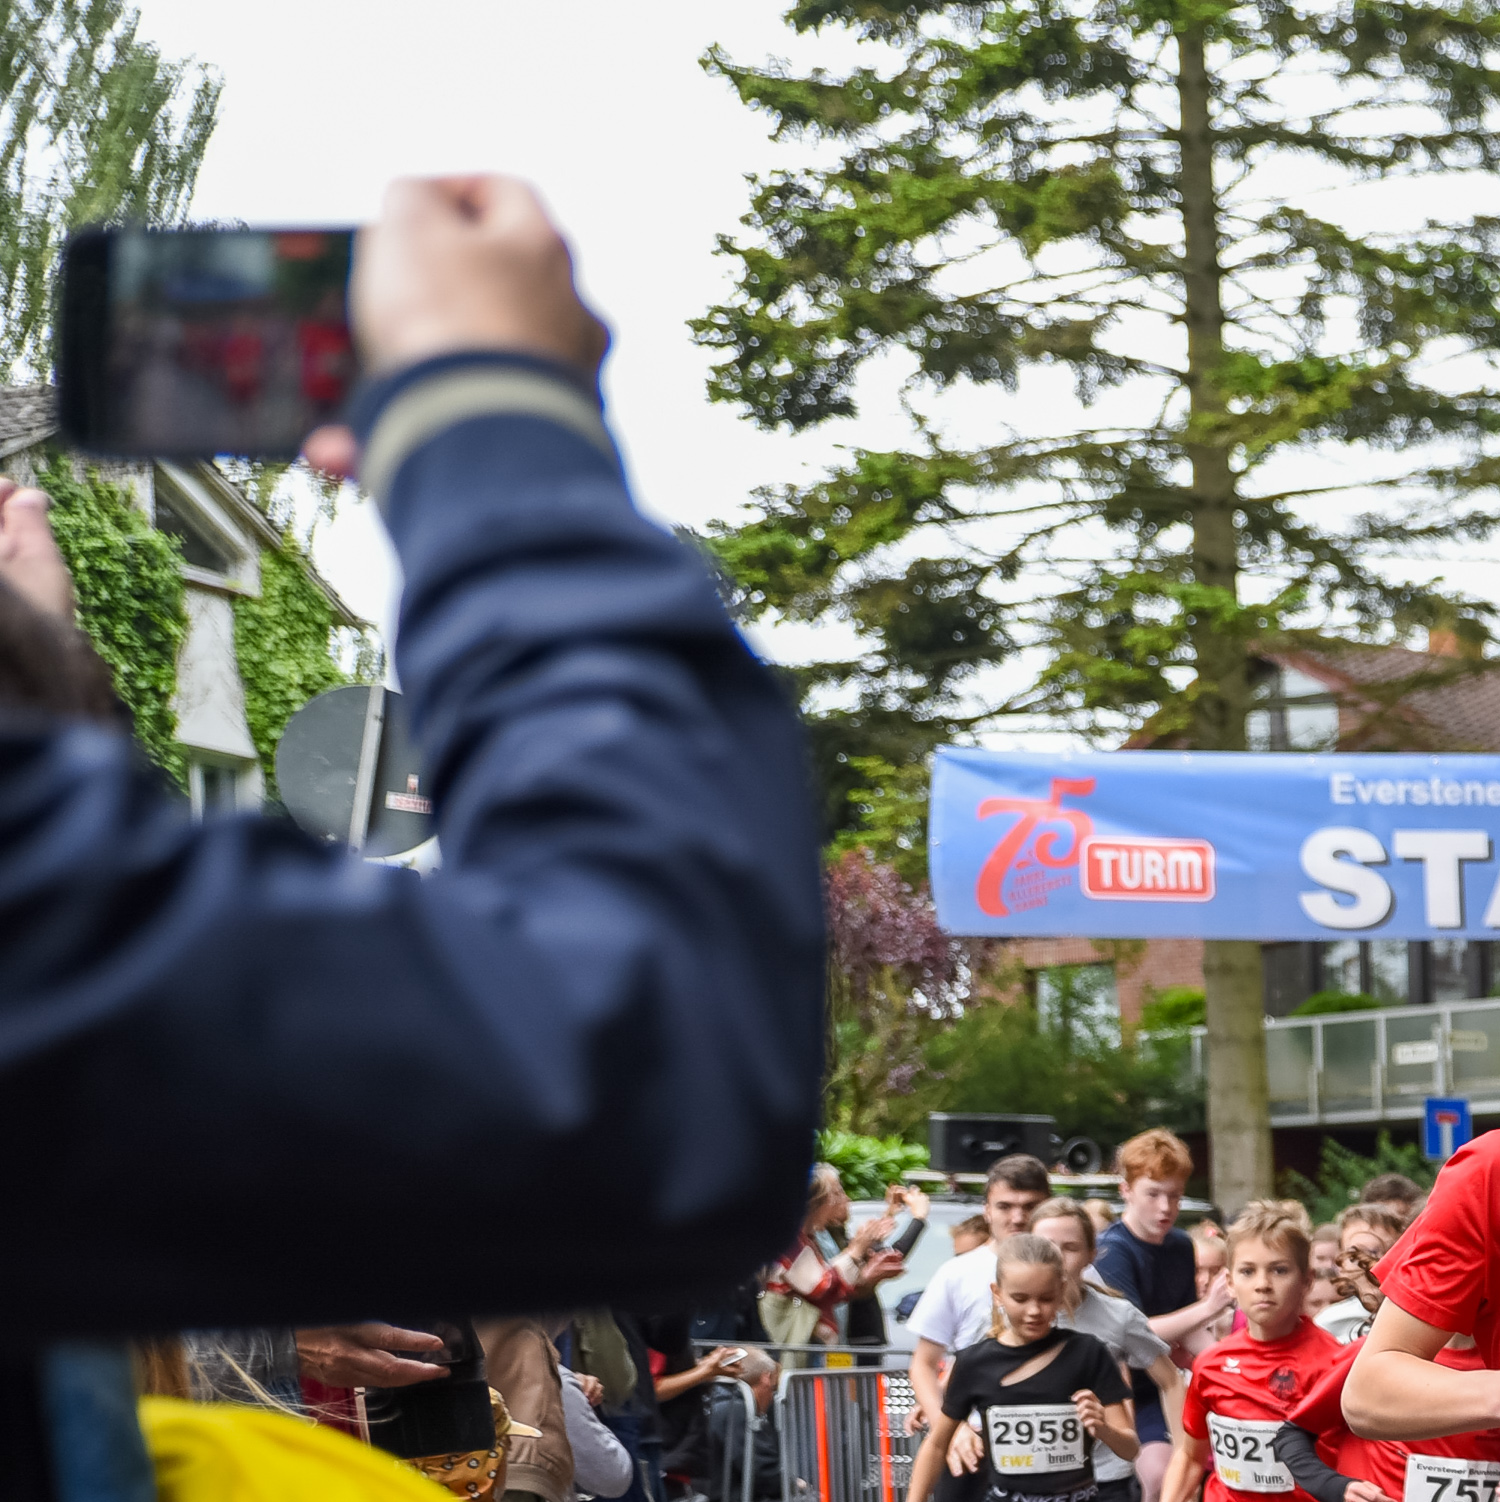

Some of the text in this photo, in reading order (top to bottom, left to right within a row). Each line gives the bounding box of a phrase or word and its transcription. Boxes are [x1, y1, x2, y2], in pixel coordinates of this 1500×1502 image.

[975, 776, 1097, 917] 75
[1092, 847, 1204, 891] TURM
[993, 1417, 1081, 1446] 2958
[1001, 1455, 1035, 1468] EWE
[1048, 1453, 1078, 1465] bruns
[1416, 1463, 1467, 1475] Everstener
[1253, 1471, 1285, 1485] bruns
